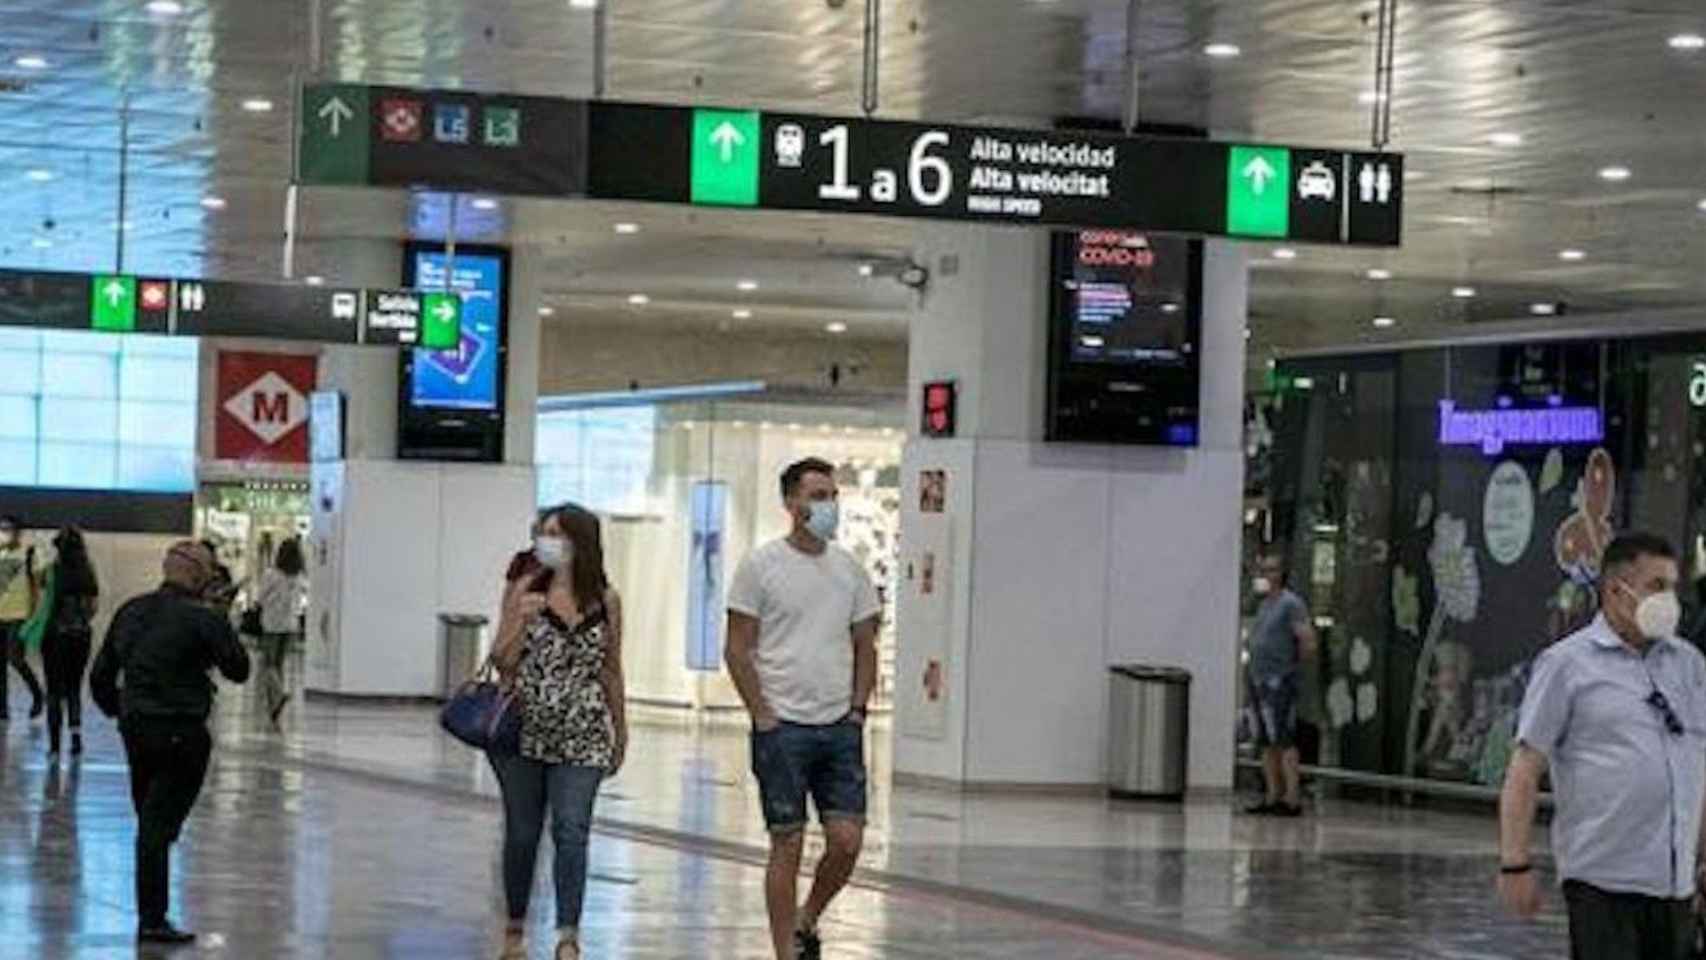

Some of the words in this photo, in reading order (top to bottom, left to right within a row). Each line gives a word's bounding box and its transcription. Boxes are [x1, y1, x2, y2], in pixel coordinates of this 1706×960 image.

[818, 125, 859, 200] 1
[871, 169, 897, 202] a
[908, 132, 951, 205] 6
[970, 136, 1012, 161] Alta
[1015, 140, 1115, 168] velocidad
[969, 166, 1012, 191] Alta
[1016, 170, 1109, 196] velocitat
[252, 392, 288, 424] M
[1439, 395, 1604, 455] Imaginarium
